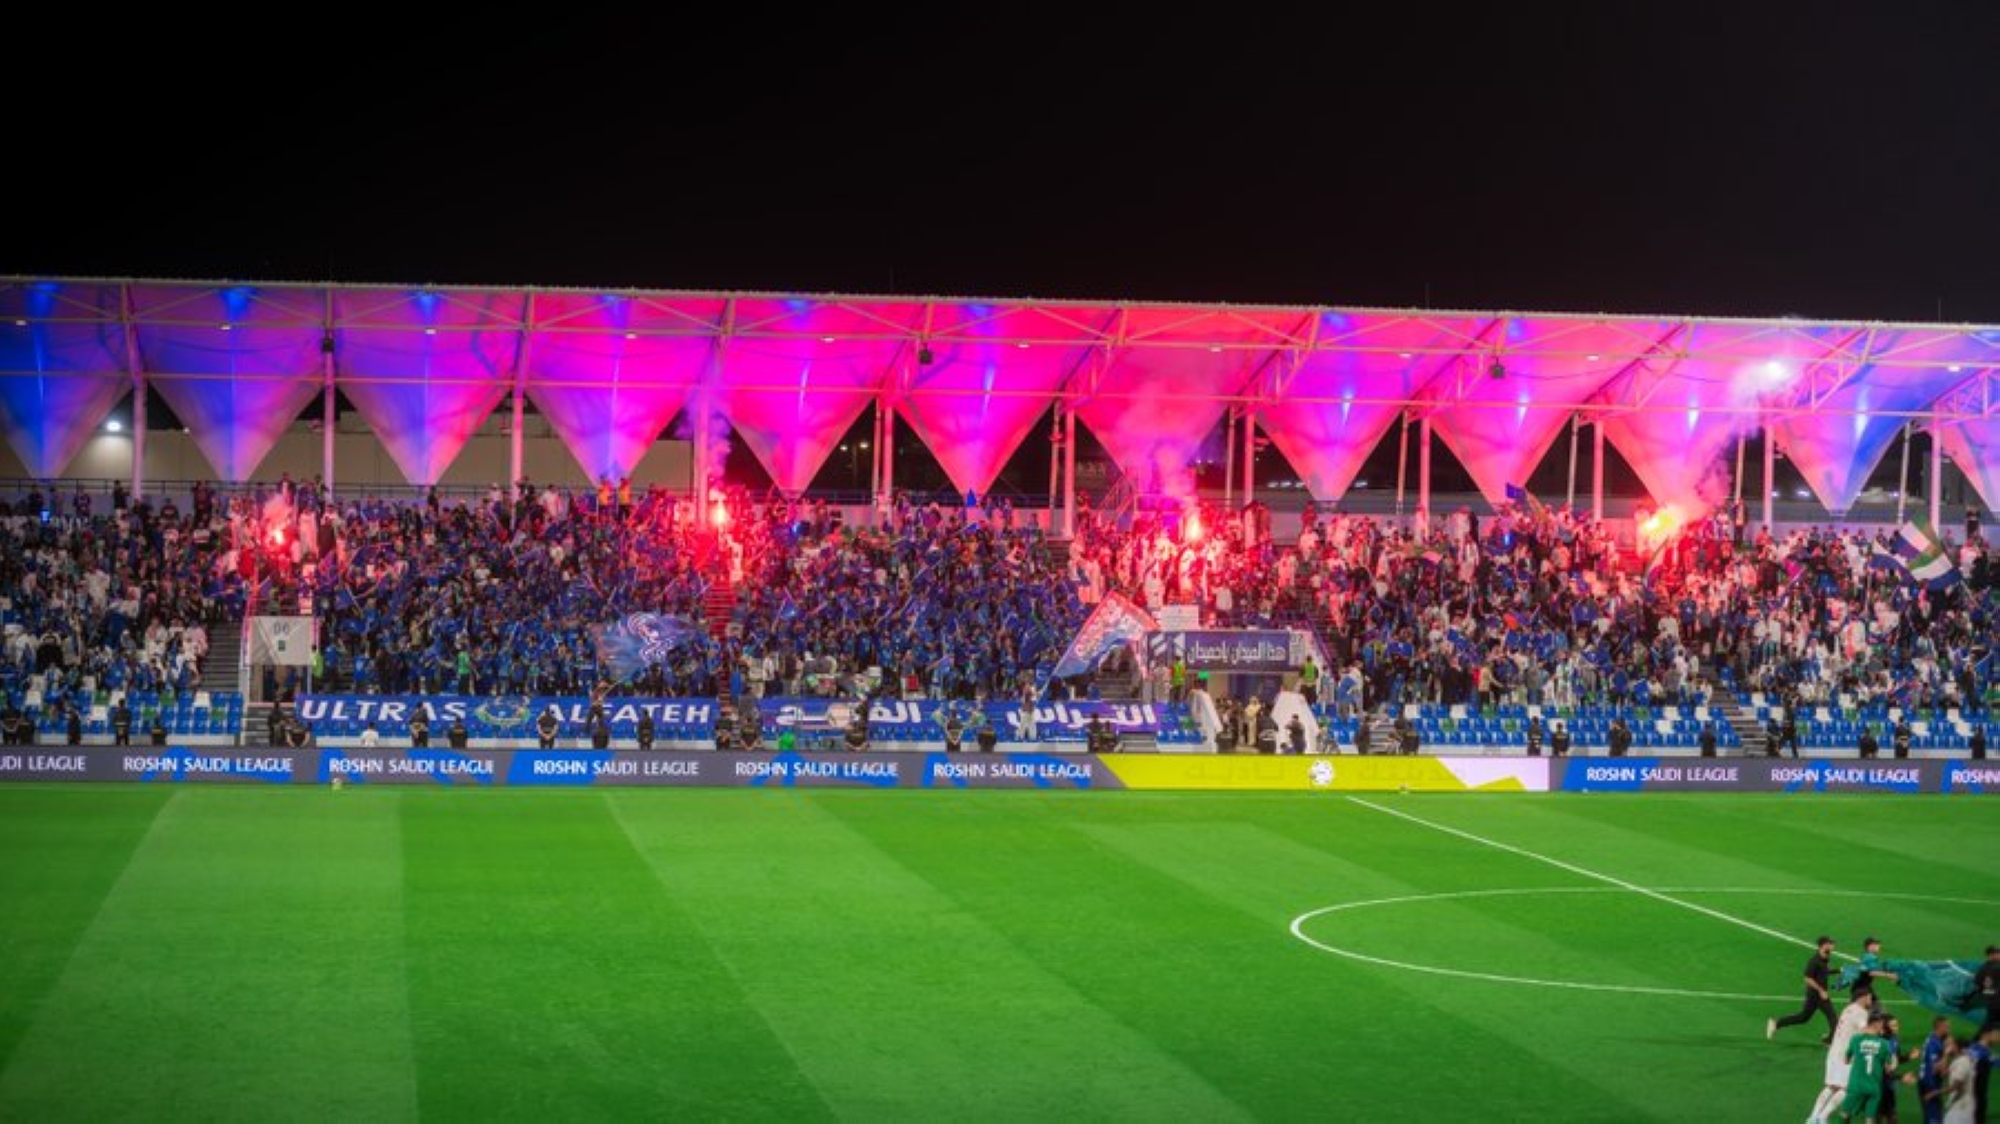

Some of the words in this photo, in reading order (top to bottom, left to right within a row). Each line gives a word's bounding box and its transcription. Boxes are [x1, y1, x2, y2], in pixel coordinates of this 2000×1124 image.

[29, 756, 86, 771] LEAGUE
[123, 757, 177, 772] ROSHN
[184, 757, 230, 772] SAUDI
[236, 758, 293, 773] LEAGUE
[329, 758, 384, 774] ROSHN
[388, 758, 434, 774] SAUDI
[534, 760, 586, 775] ROSHN
[593, 760, 638, 775] SAUDI
[644, 761, 699, 776] LEAGUE
[735, 761, 787, 776] ROSHN
[793, 761, 837, 776] SAUDI
[843, 762, 898, 777] LEAGUE
[934, 763, 986, 778] ROSHN
[990, 763, 1035, 778] SAUDI
[1586, 766, 1635, 781] ROSHN
[1640, 766, 1681, 781] SAUDI
[1687, 767, 1738, 782] LEAGUE
[1771, 768, 1819, 783] ROSHN
[1824, 768, 1864, 783] SAUDI
[1869, 769, 1919, 784] LEAGUE
[1951, 770, 2000, 784] ROSHN
[1865, 1055, 1872, 1075] 1
